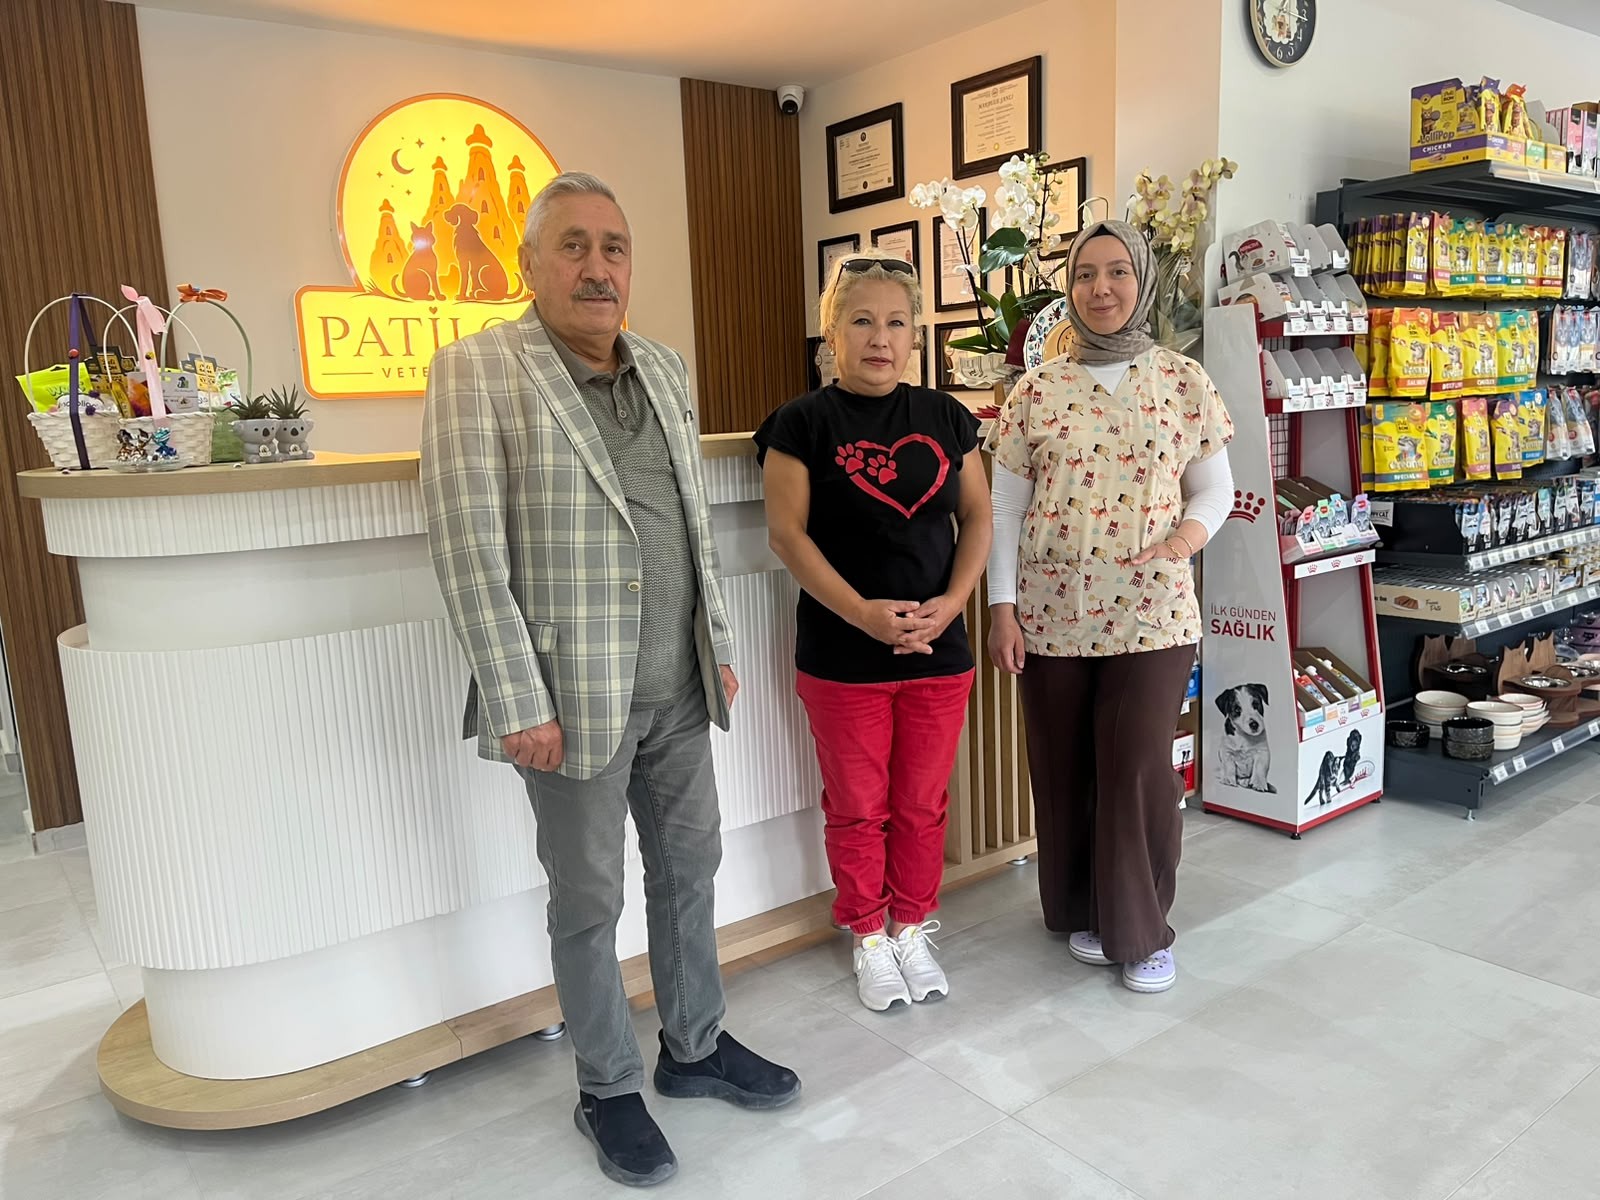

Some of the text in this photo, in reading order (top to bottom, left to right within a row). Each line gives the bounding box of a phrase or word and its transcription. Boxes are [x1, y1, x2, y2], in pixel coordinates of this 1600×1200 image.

[1276, 46, 1283, 60] 6
[1422, 143, 1452, 153] CHICKEN
[1211, 603, 1276, 621] İLK GÜNDEN
[1211, 619, 1275, 641] SAĞLIK
